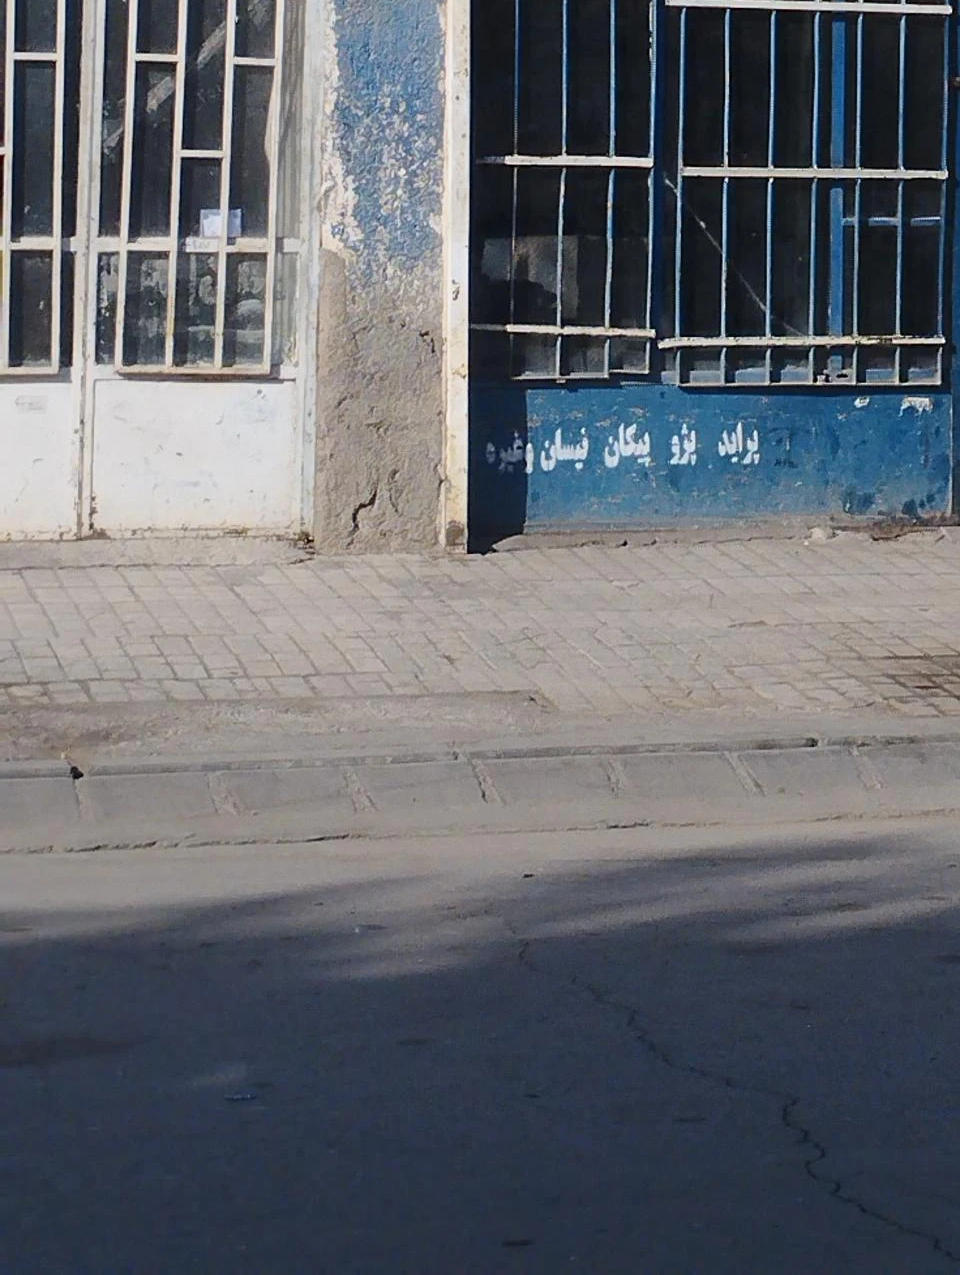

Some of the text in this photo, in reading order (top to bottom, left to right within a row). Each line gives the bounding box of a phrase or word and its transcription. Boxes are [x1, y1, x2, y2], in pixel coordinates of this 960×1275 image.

[540, 427, 588, 471] نیسان
[605, 423, 650, 467] پیکان
[669, 424, 696, 465] پژو
[718, 422, 760, 465] پراید
